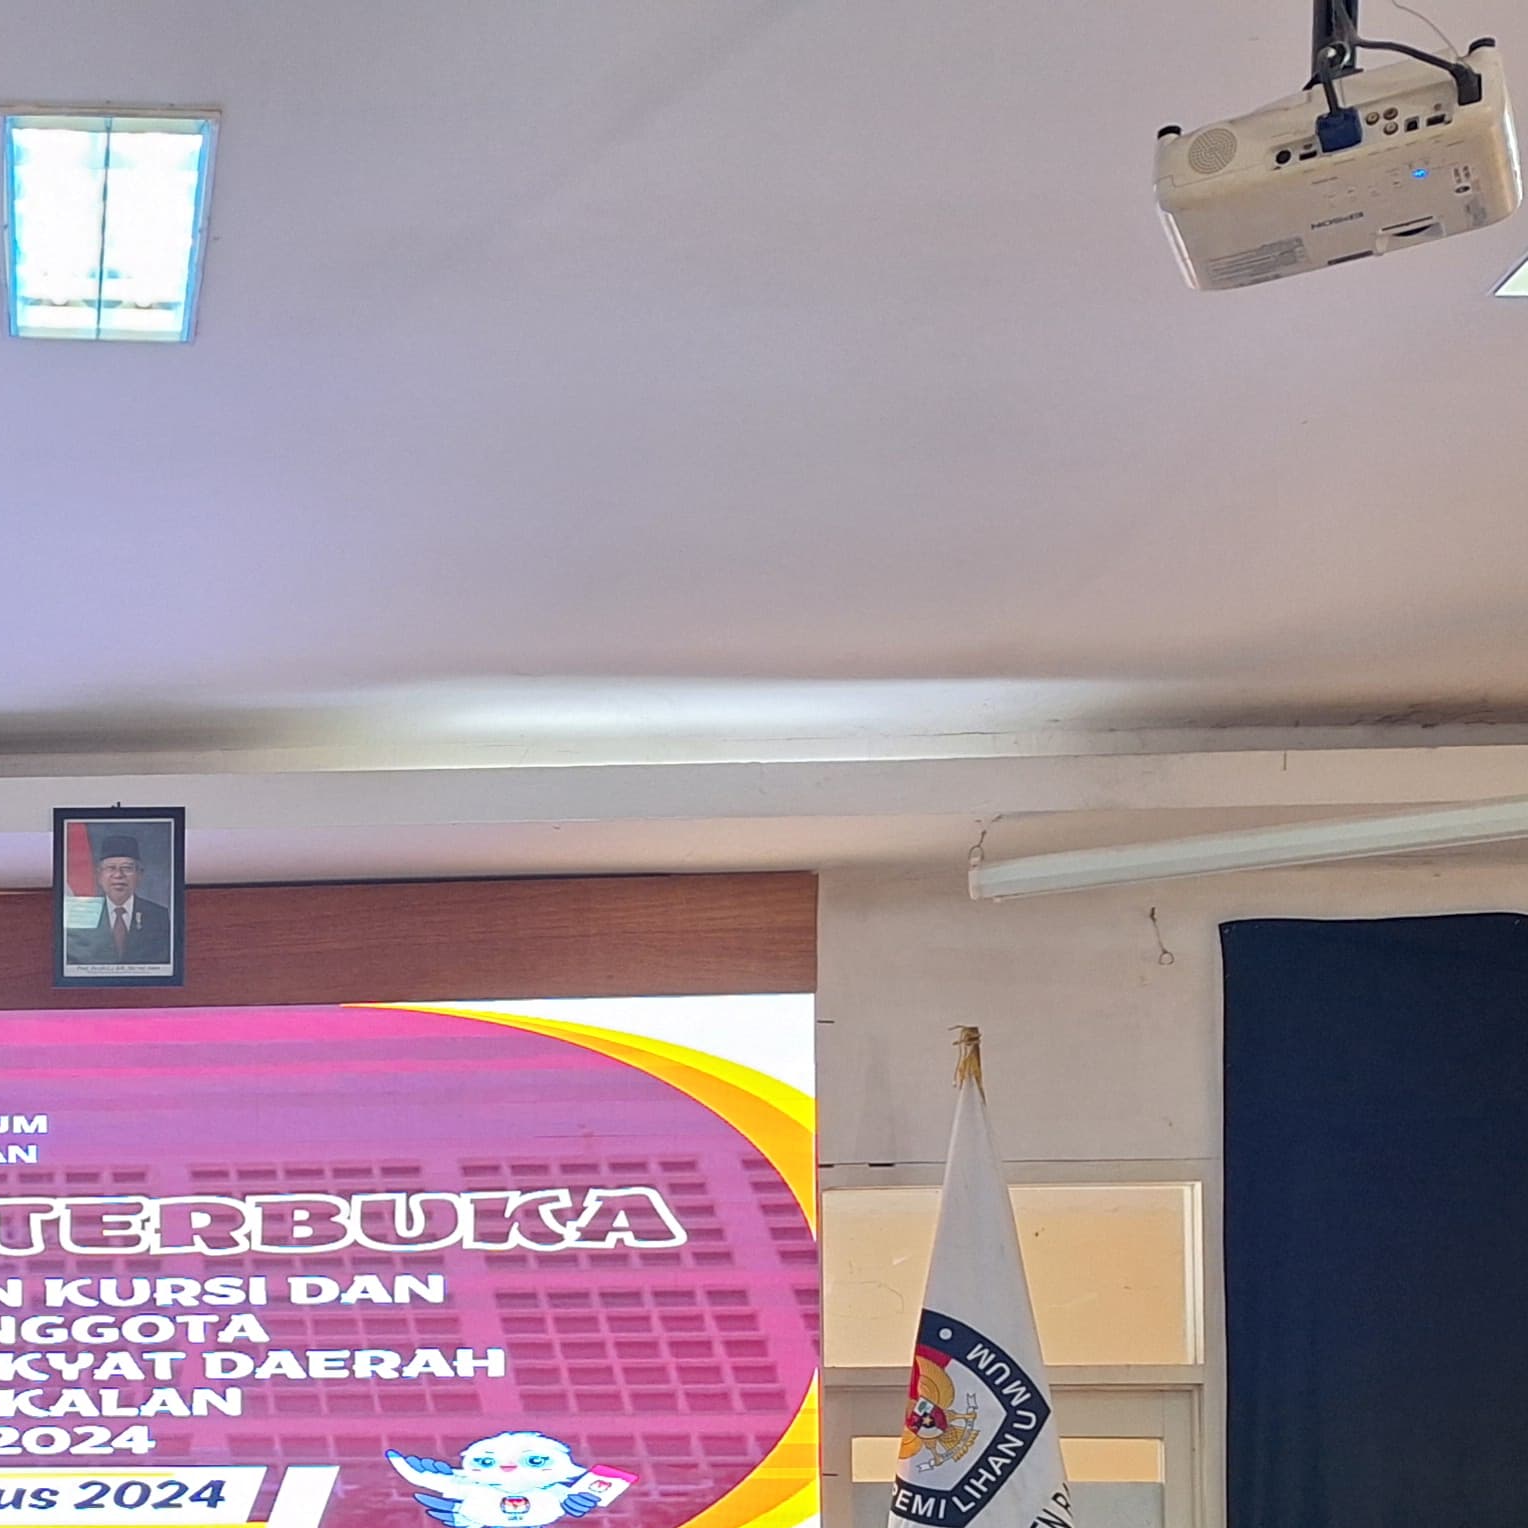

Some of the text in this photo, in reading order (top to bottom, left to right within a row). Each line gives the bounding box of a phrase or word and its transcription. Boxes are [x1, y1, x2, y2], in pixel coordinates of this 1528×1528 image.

[44, 1276, 267, 1307] KURSI
[287, 1274, 444, 1305] DAN
[202, 1348, 505, 1379] DAERAH
[966, 1343, 1038, 1432] UMUM
[74, 1479, 226, 1509] 2024
